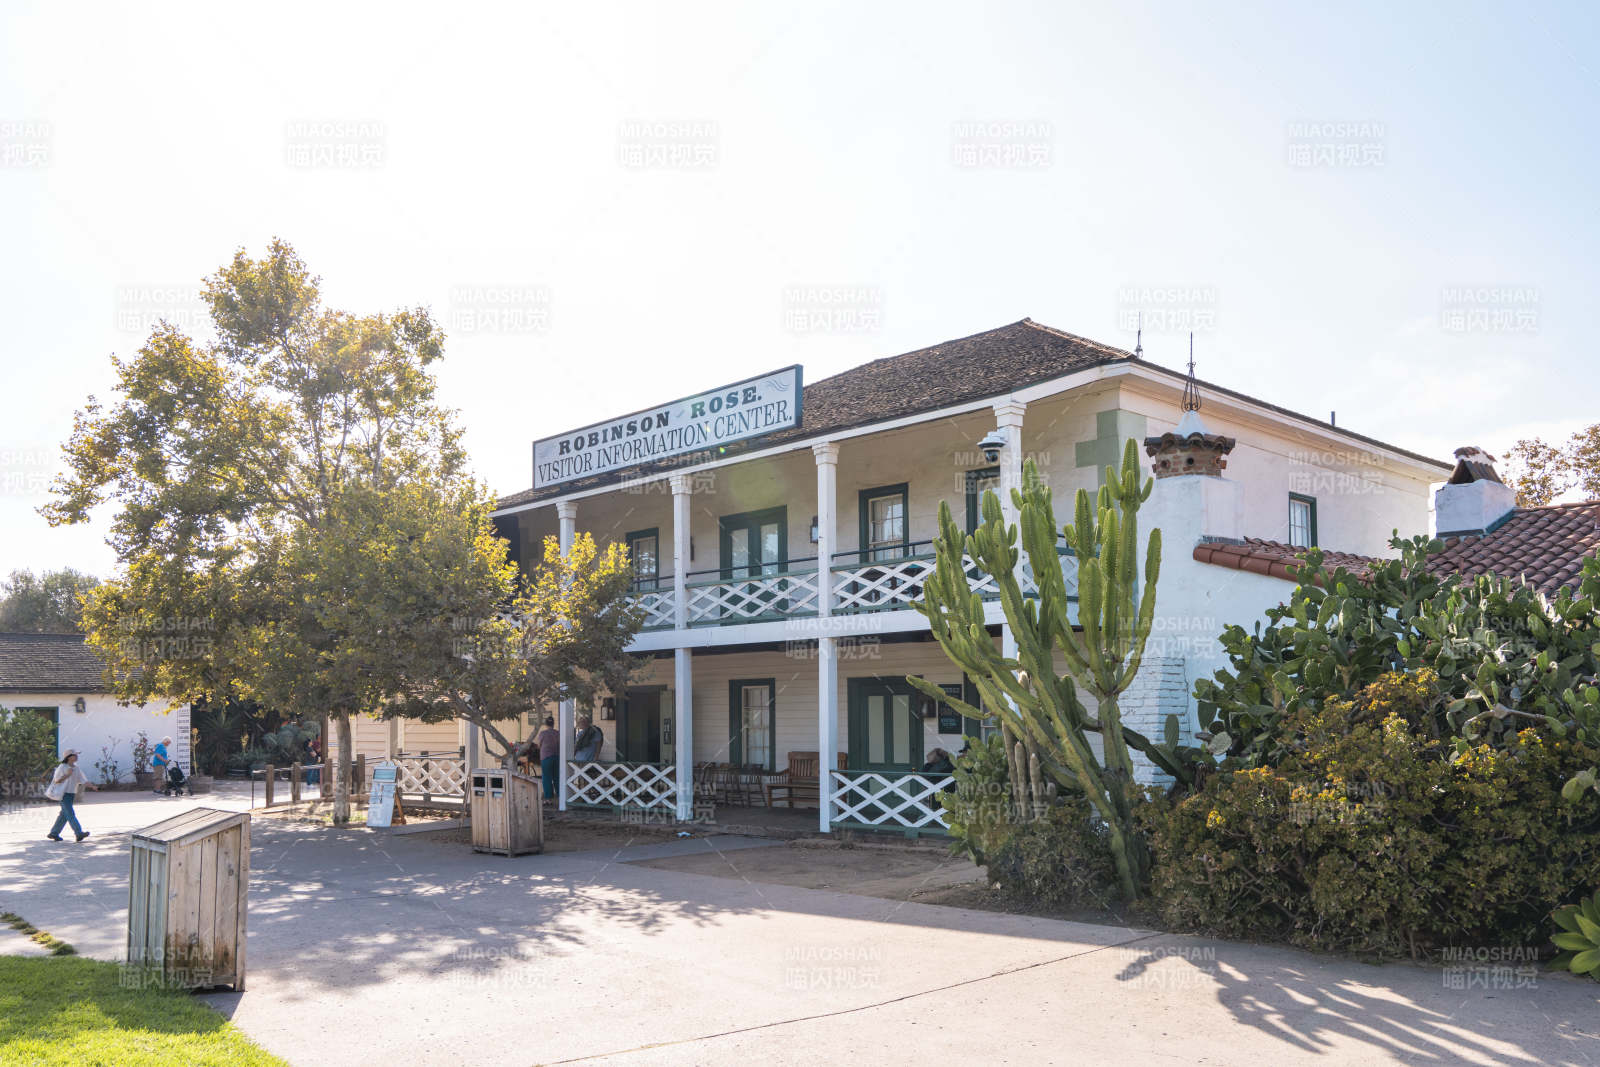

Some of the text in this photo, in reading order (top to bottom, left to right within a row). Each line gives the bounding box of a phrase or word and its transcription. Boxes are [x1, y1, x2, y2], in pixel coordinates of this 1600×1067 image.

[538, 400, 792, 483] VISITOR INFORMATION CENTER.
[559, 386, 762, 455] ROBINSON ROSE.
